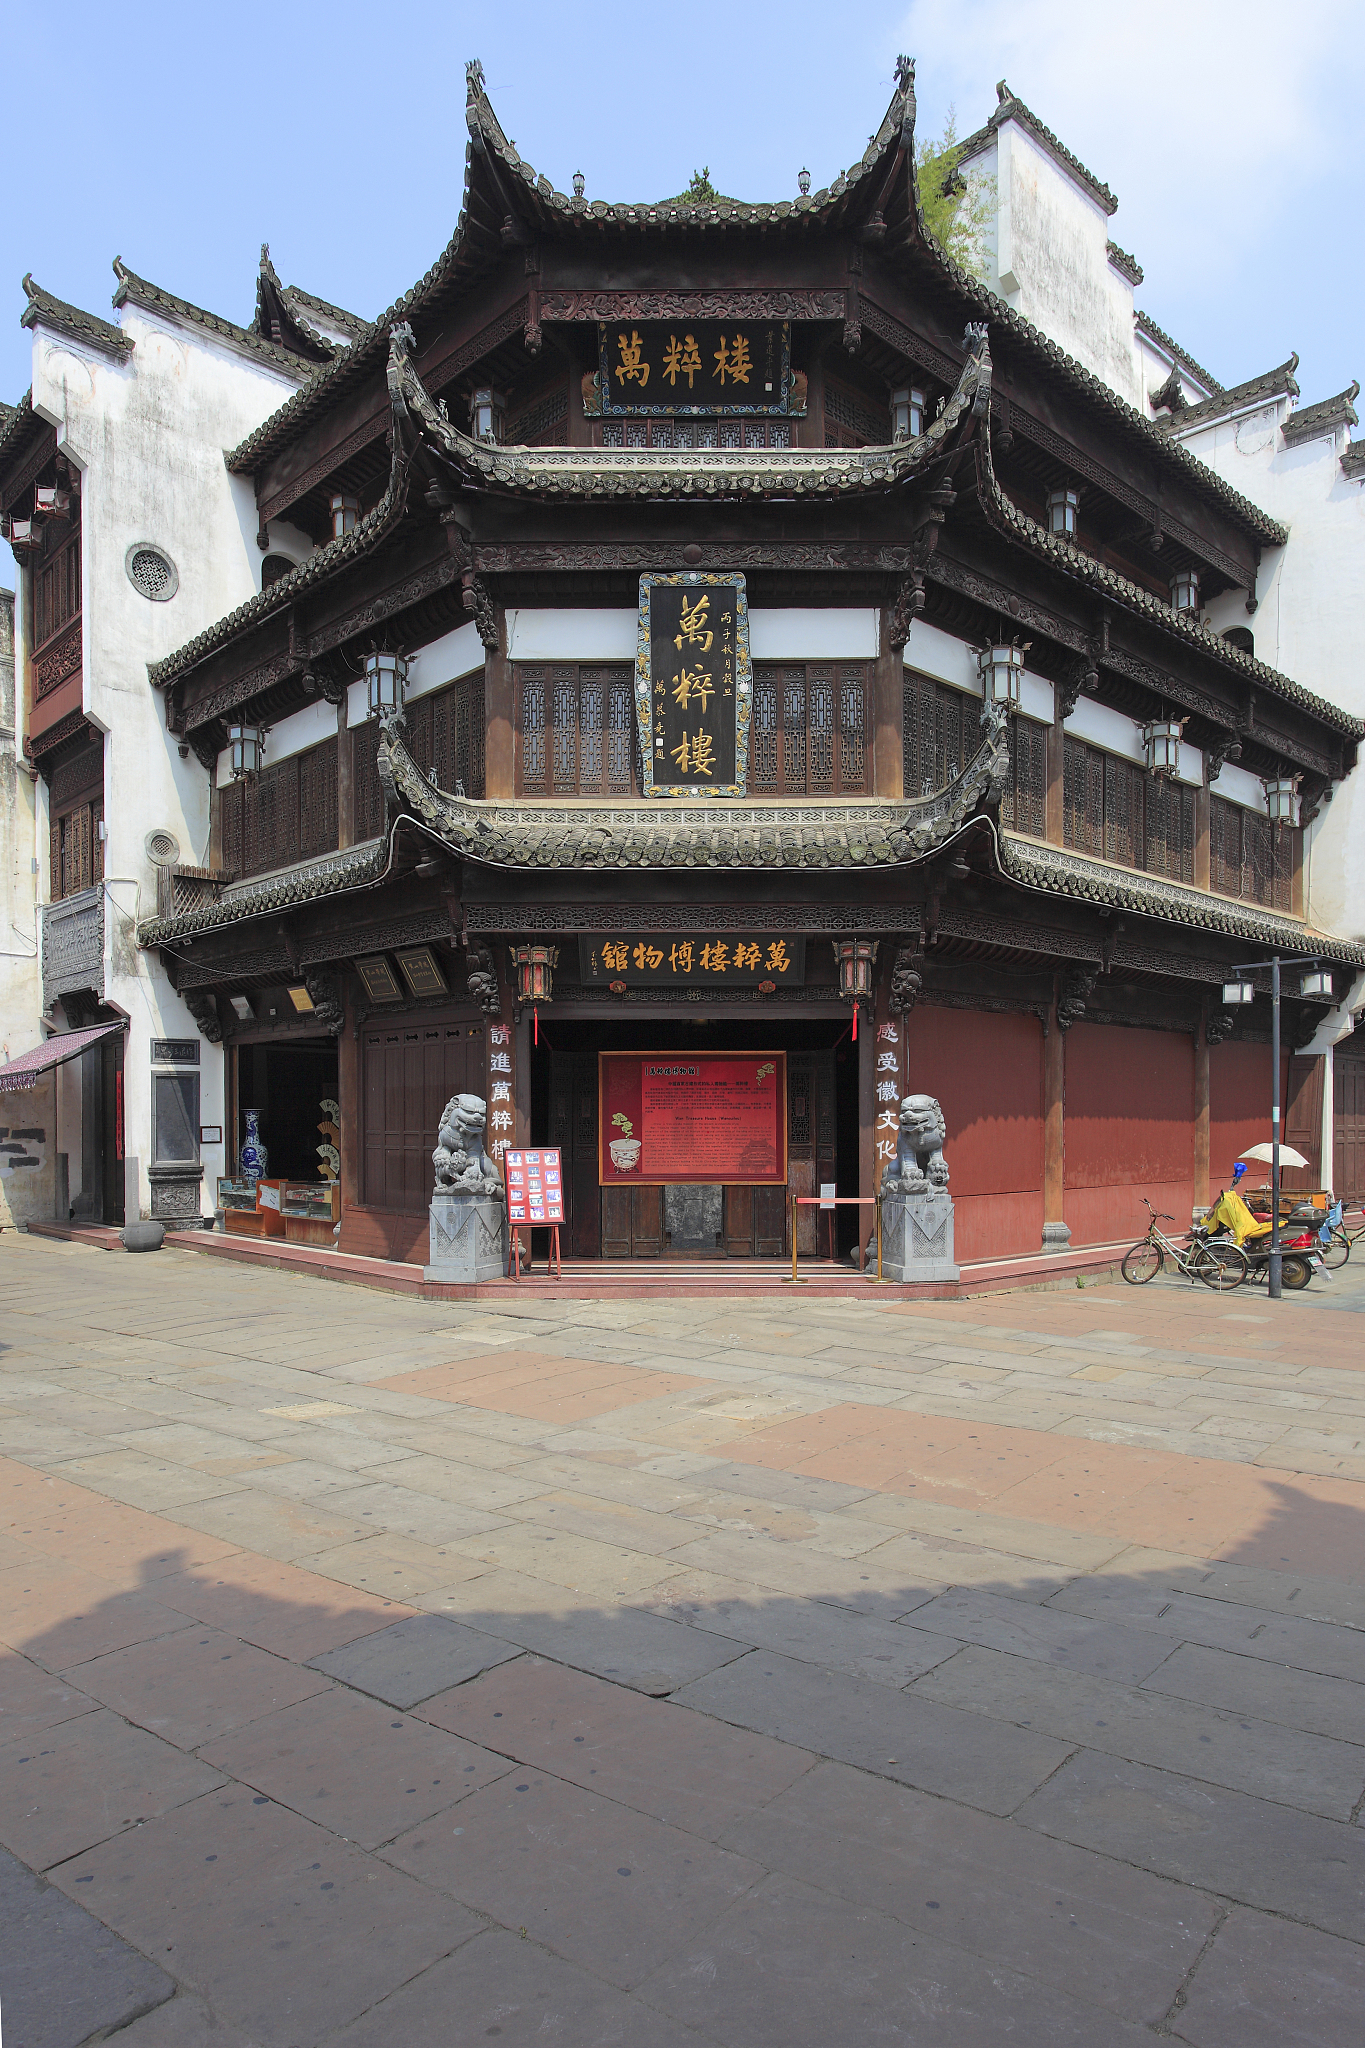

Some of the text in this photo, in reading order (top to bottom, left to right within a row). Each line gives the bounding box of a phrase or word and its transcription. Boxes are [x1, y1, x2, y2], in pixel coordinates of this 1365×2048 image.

[614, 330, 754, 389] 萬粹楼
[670, 594, 717, 776] 萬粹樓
[876, 1022, 899, 1160] 感受徽文化
